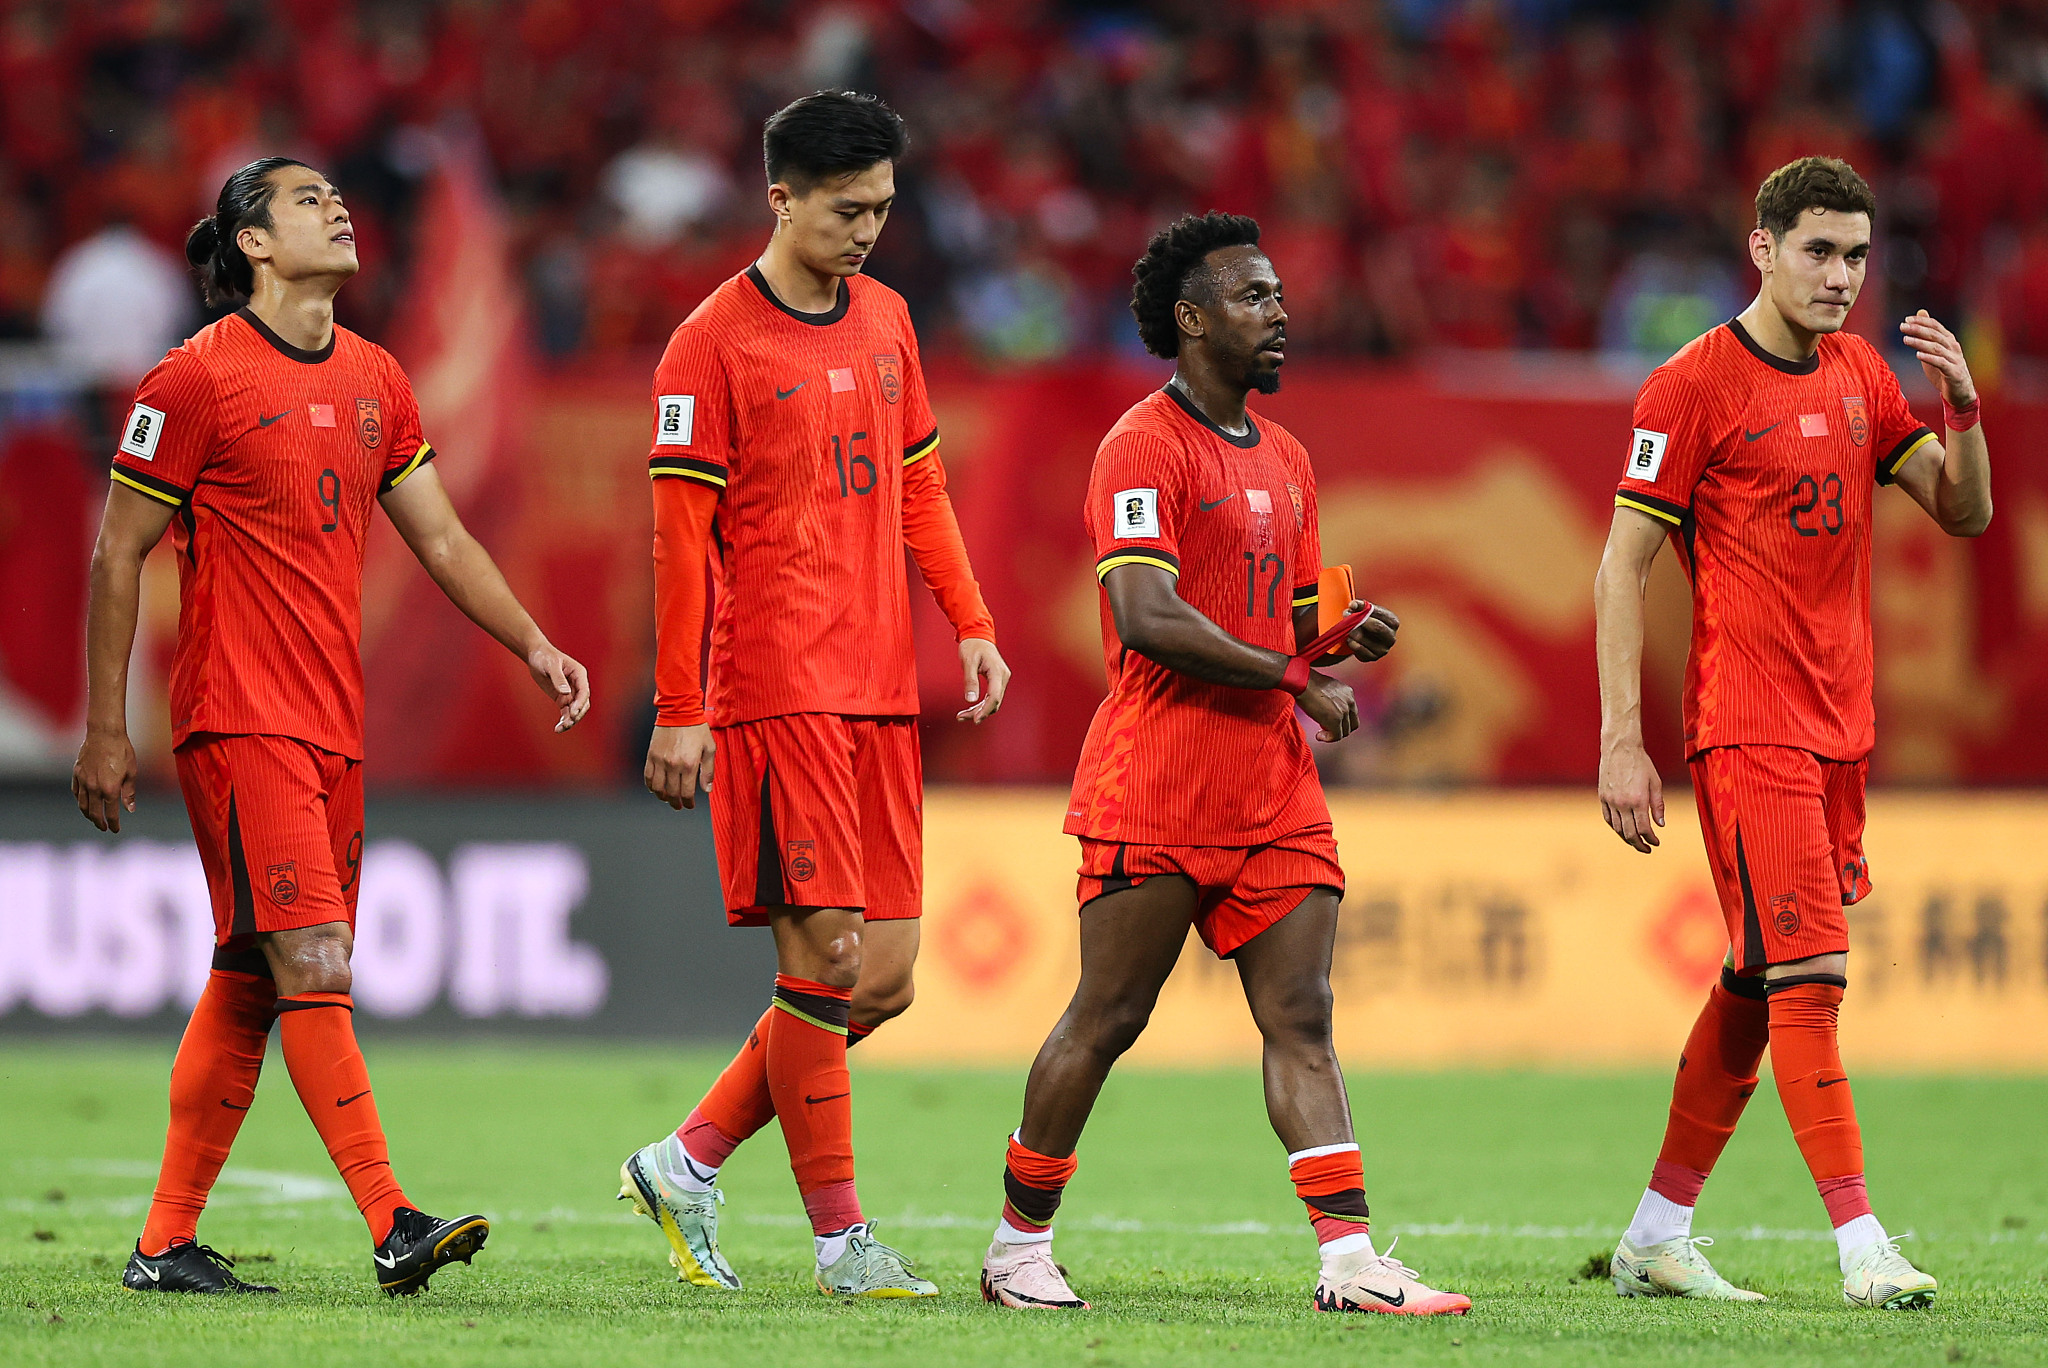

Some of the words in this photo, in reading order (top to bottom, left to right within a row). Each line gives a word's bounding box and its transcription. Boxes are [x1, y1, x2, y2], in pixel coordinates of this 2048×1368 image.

[831, 431, 878, 498] 16
[318, 468, 341, 533] 9
[1789, 472, 1844, 537] 23
[1243, 551, 1285, 618] 17
[341, 830, 363, 893] 9
